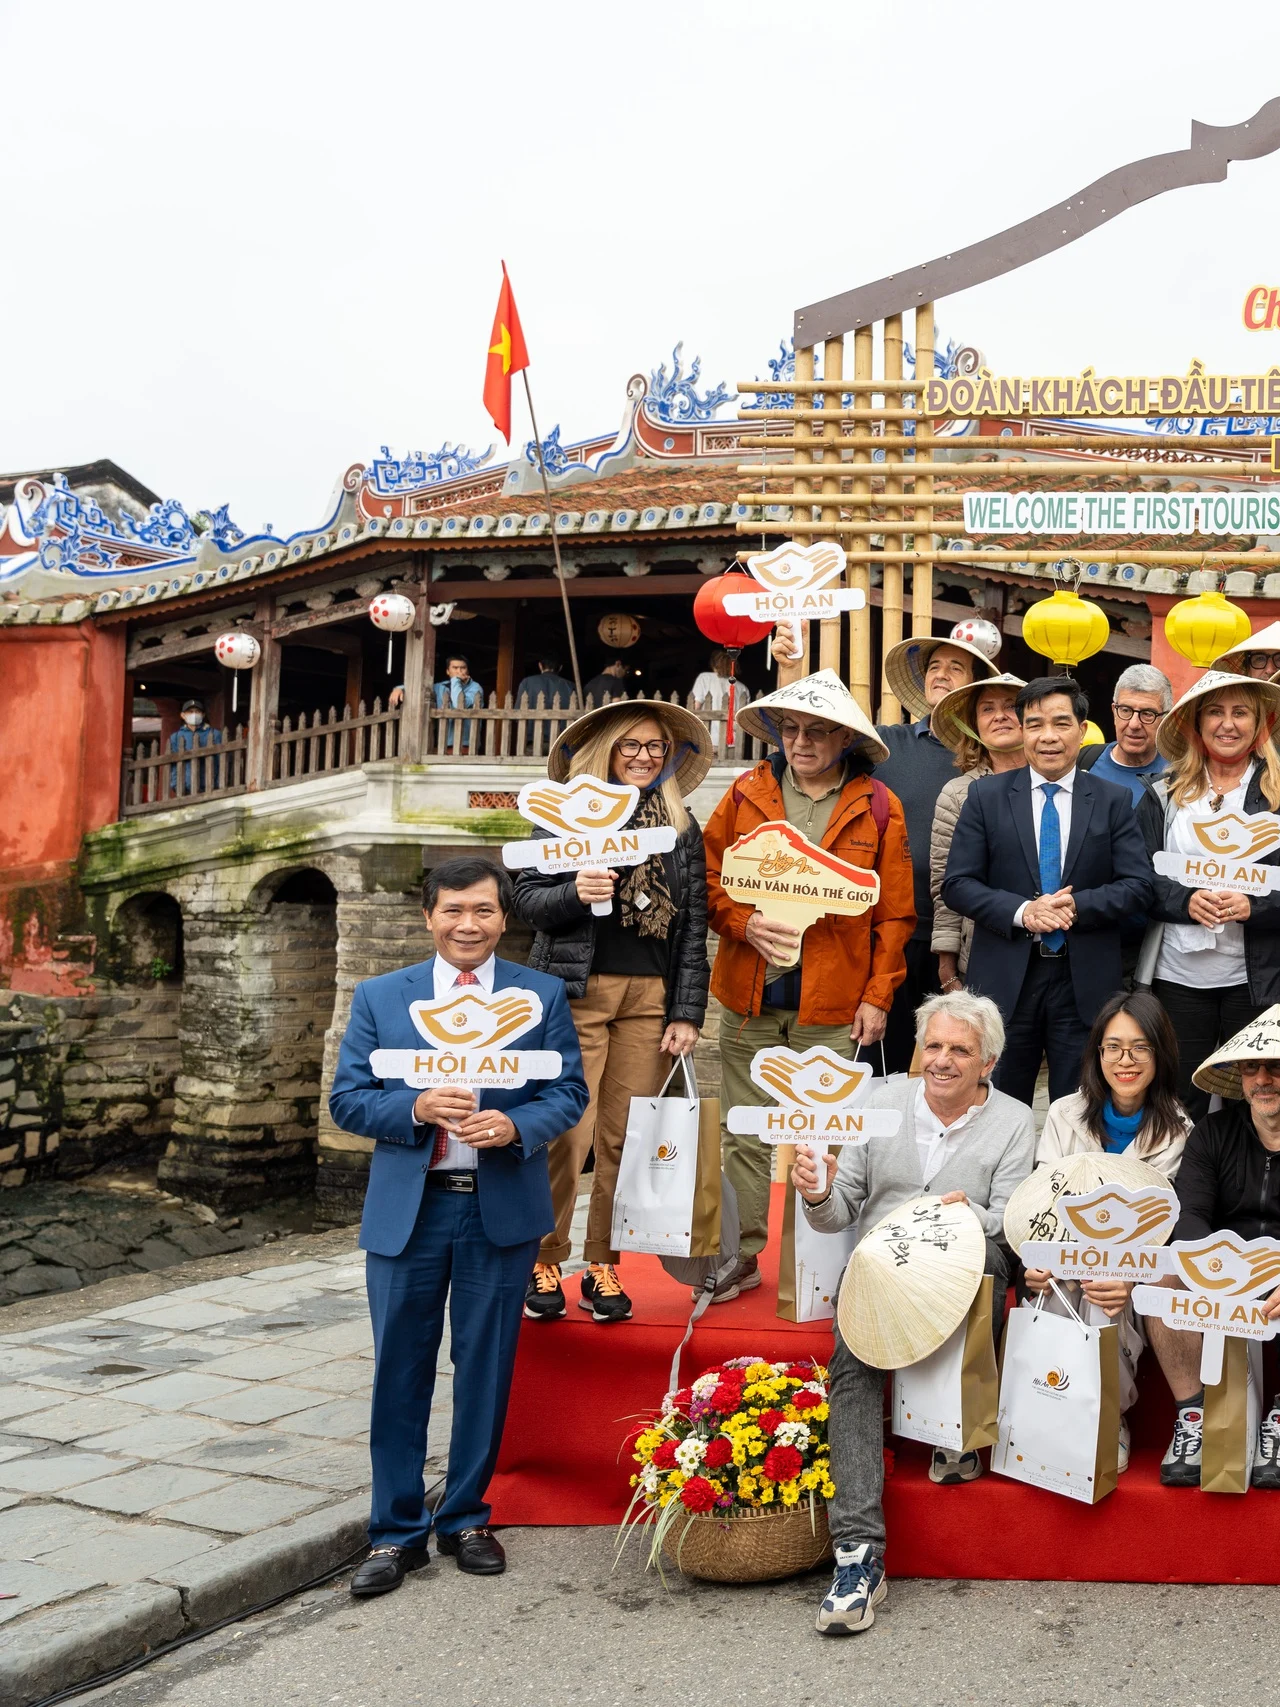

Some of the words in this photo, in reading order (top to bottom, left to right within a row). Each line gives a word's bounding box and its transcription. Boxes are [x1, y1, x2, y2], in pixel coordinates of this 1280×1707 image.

[927, 370, 1020, 411] ĐOÀN
[1032, 370, 1146, 411] KHÁCH
[1161, 360, 1227, 410] ĐẦU
[969, 497, 1077, 528] WELCOME
[1085, 497, 1126, 529] THE
[1134, 497, 1194, 529] FIRST
[756, 593, 794, 613] HỘI
[802, 594, 833, 608] AN
[543, 837, 591, 861] HỘI
[602, 835, 639, 854] AN
[792, 857, 820, 875] An
[1185, 859, 1225, 881] HỘI
[1234, 867, 1267, 883] AN
[722, 876, 733, 886] DI
[738, 876, 761, 889] SẢN
[765, 880, 789, 893] VĂN
[793, 884, 818, 896] HÓA
[823, 887, 844, 899] THẾ
[847, 891, 873, 903] GIỚI
[414, 1052, 465, 1078] HỘI
[477, 1057, 519, 1073] AN
[768, 1109, 815, 1134] HỘI
[825, 1115, 863, 1131] AN
[1060, 1246, 1108, 1270] HỘI
[1118, 1252, 1157, 1269] AN
[1171, 1296, 1220, 1322] HỘI
[1229, 1305, 1269, 1326] AN
[1197, 1321, 1220, 1331] CRAFTS
